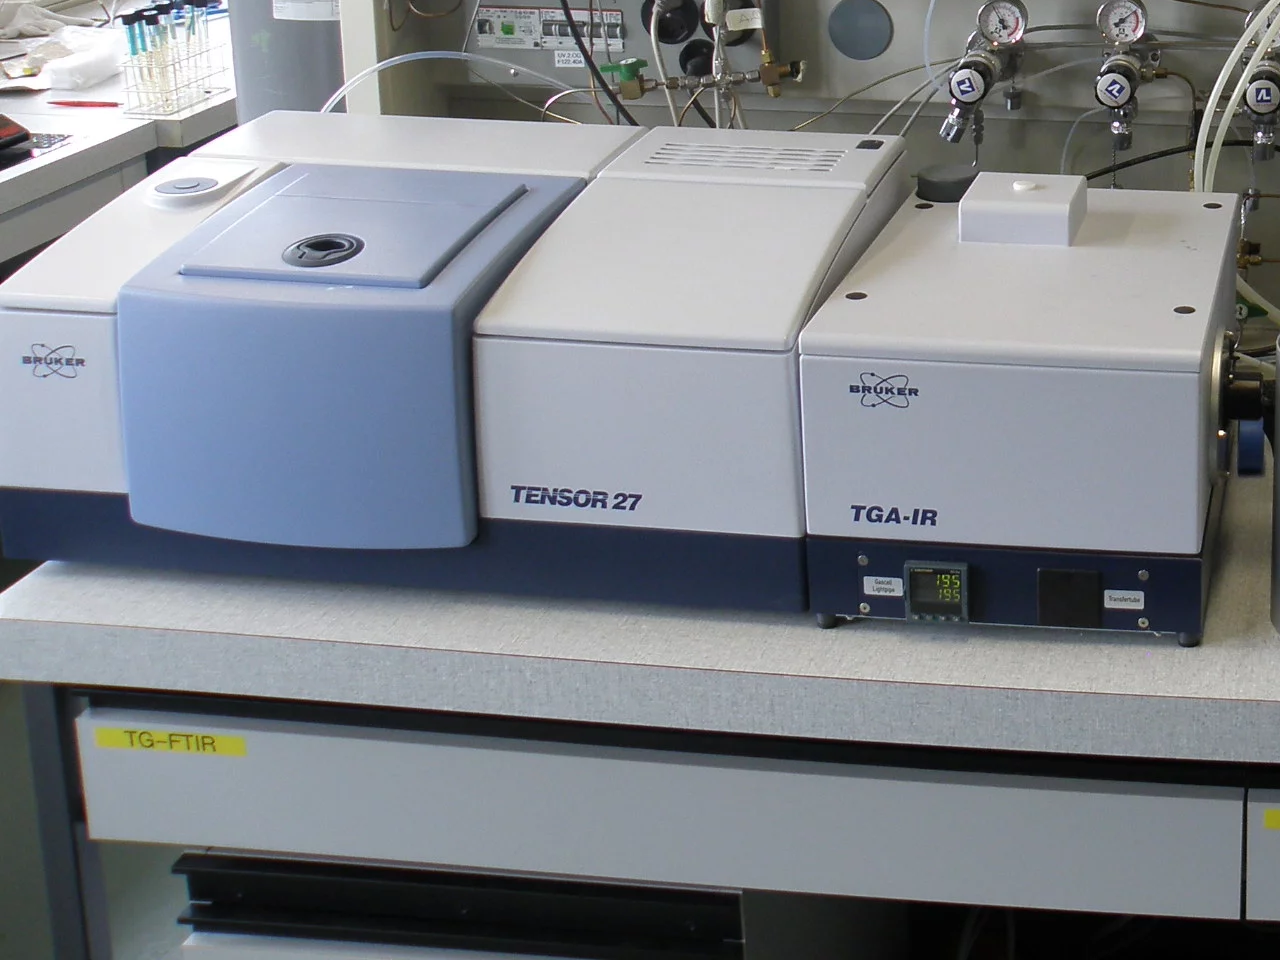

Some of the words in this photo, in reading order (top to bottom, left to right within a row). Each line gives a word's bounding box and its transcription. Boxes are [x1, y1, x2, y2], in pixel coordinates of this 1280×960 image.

[22, 356, 86, 367] BRUKER
[849, 384, 919, 396] BRUKER
[510, 485, 609, 509] TENSOR
[611, 492, 643, 511] 27
[850, 504, 938, 526] TGA-IR
[937, 574, 960, 588] 195
[939, 589, 961, 601] 195
[124, 730, 217, 752] TG-FTIR
